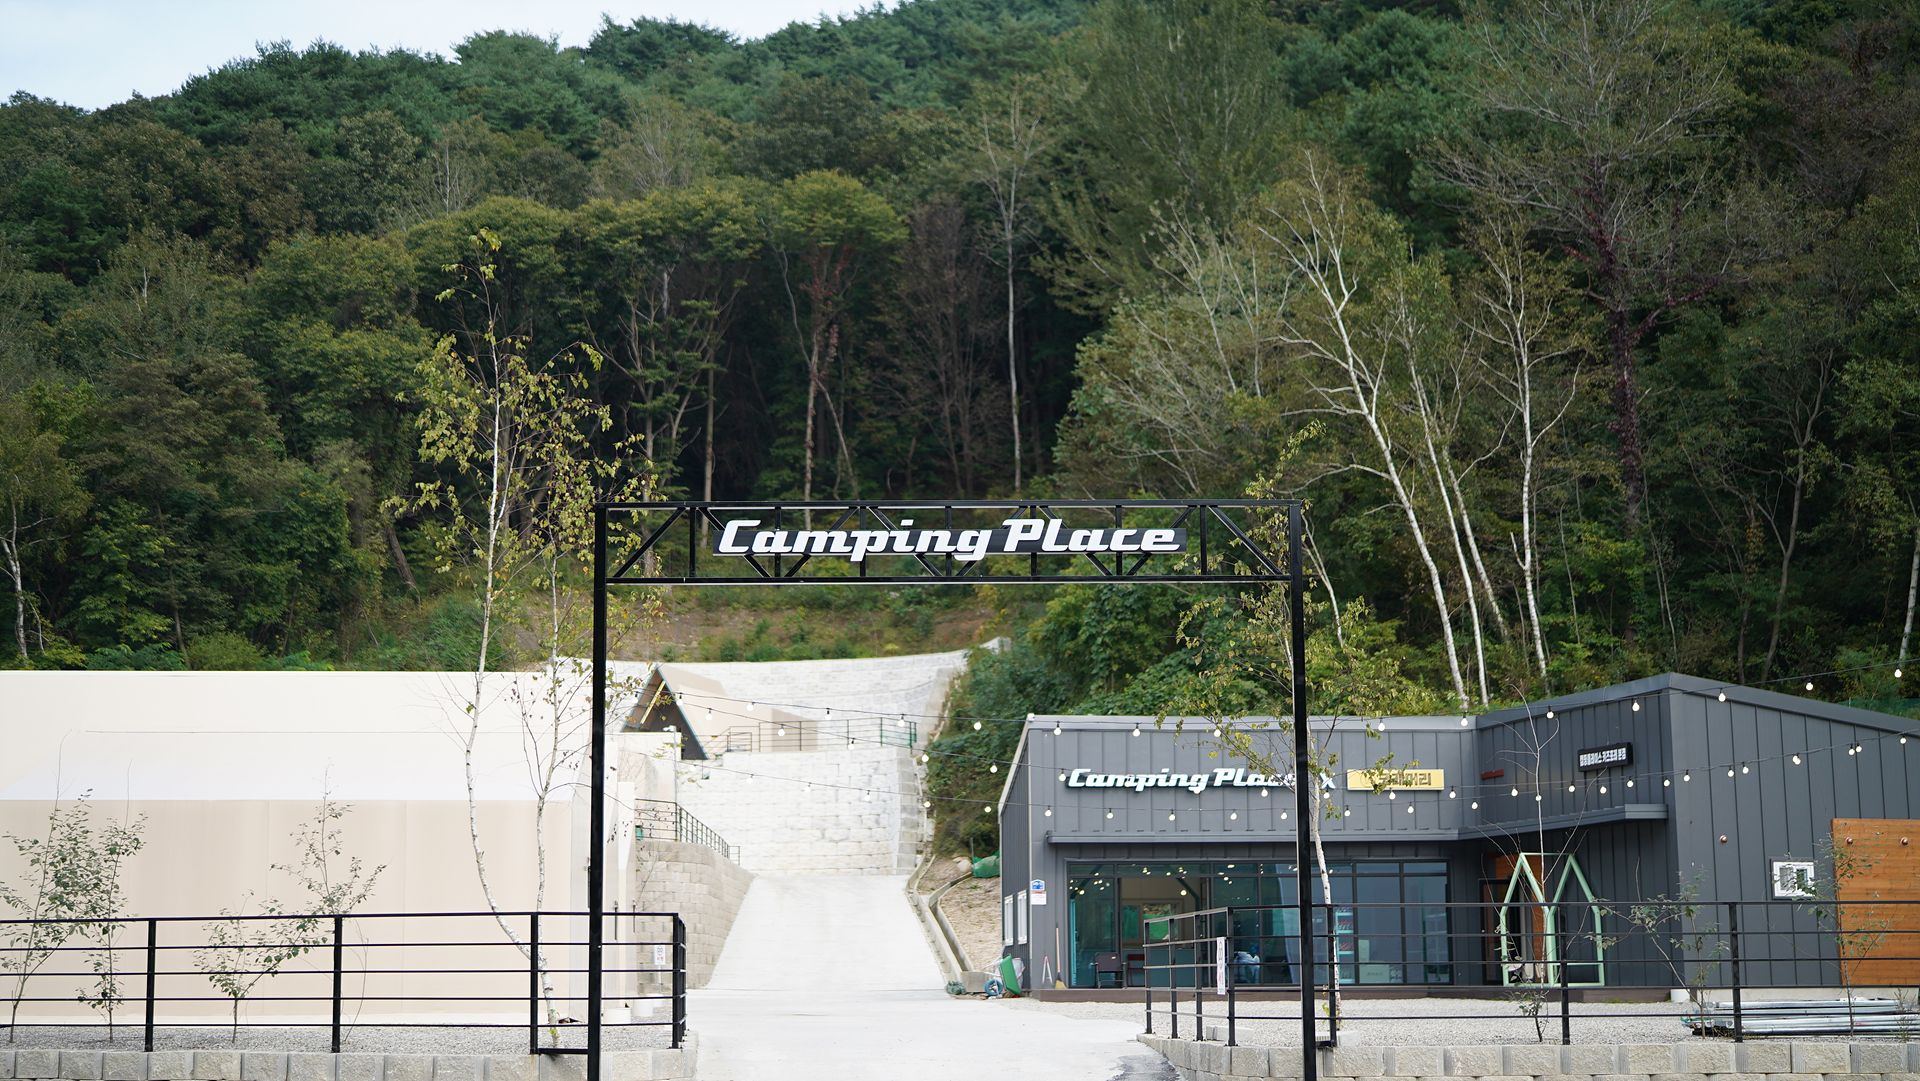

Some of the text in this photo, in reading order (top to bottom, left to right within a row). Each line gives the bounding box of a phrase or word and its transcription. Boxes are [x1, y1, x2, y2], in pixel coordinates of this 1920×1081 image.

[718, 518, 1180, 562] Camping Place
[1068, 767, 1209, 792] Camping
